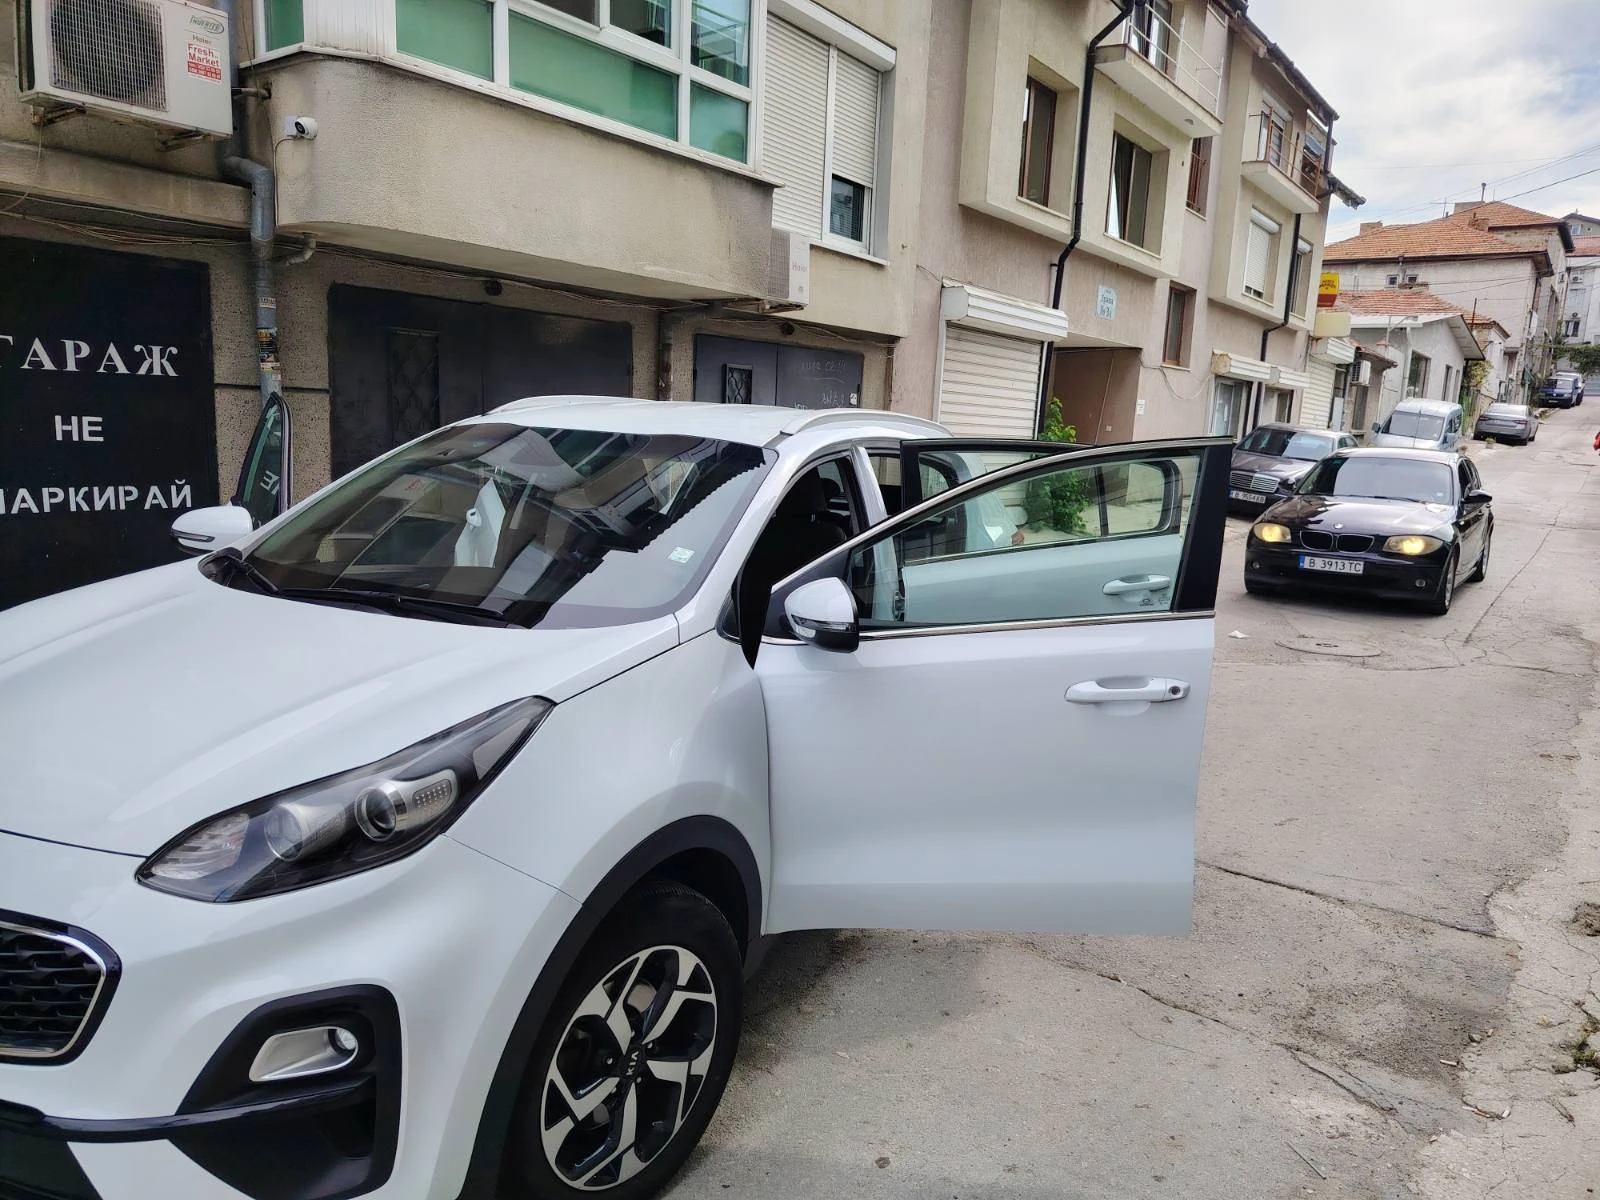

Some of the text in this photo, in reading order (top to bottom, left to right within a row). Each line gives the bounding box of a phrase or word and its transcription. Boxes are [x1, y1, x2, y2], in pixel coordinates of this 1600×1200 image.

[188, 44, 214, 57] Fresh
[188, 52, 220, 67] Market
[55, 415, 104, 442] НЕ
[0, 479, 192, 514] АРКИРАЙ
[1309, 558, 1316, 567] B
[626, 1051, 639, 1076] KIA
